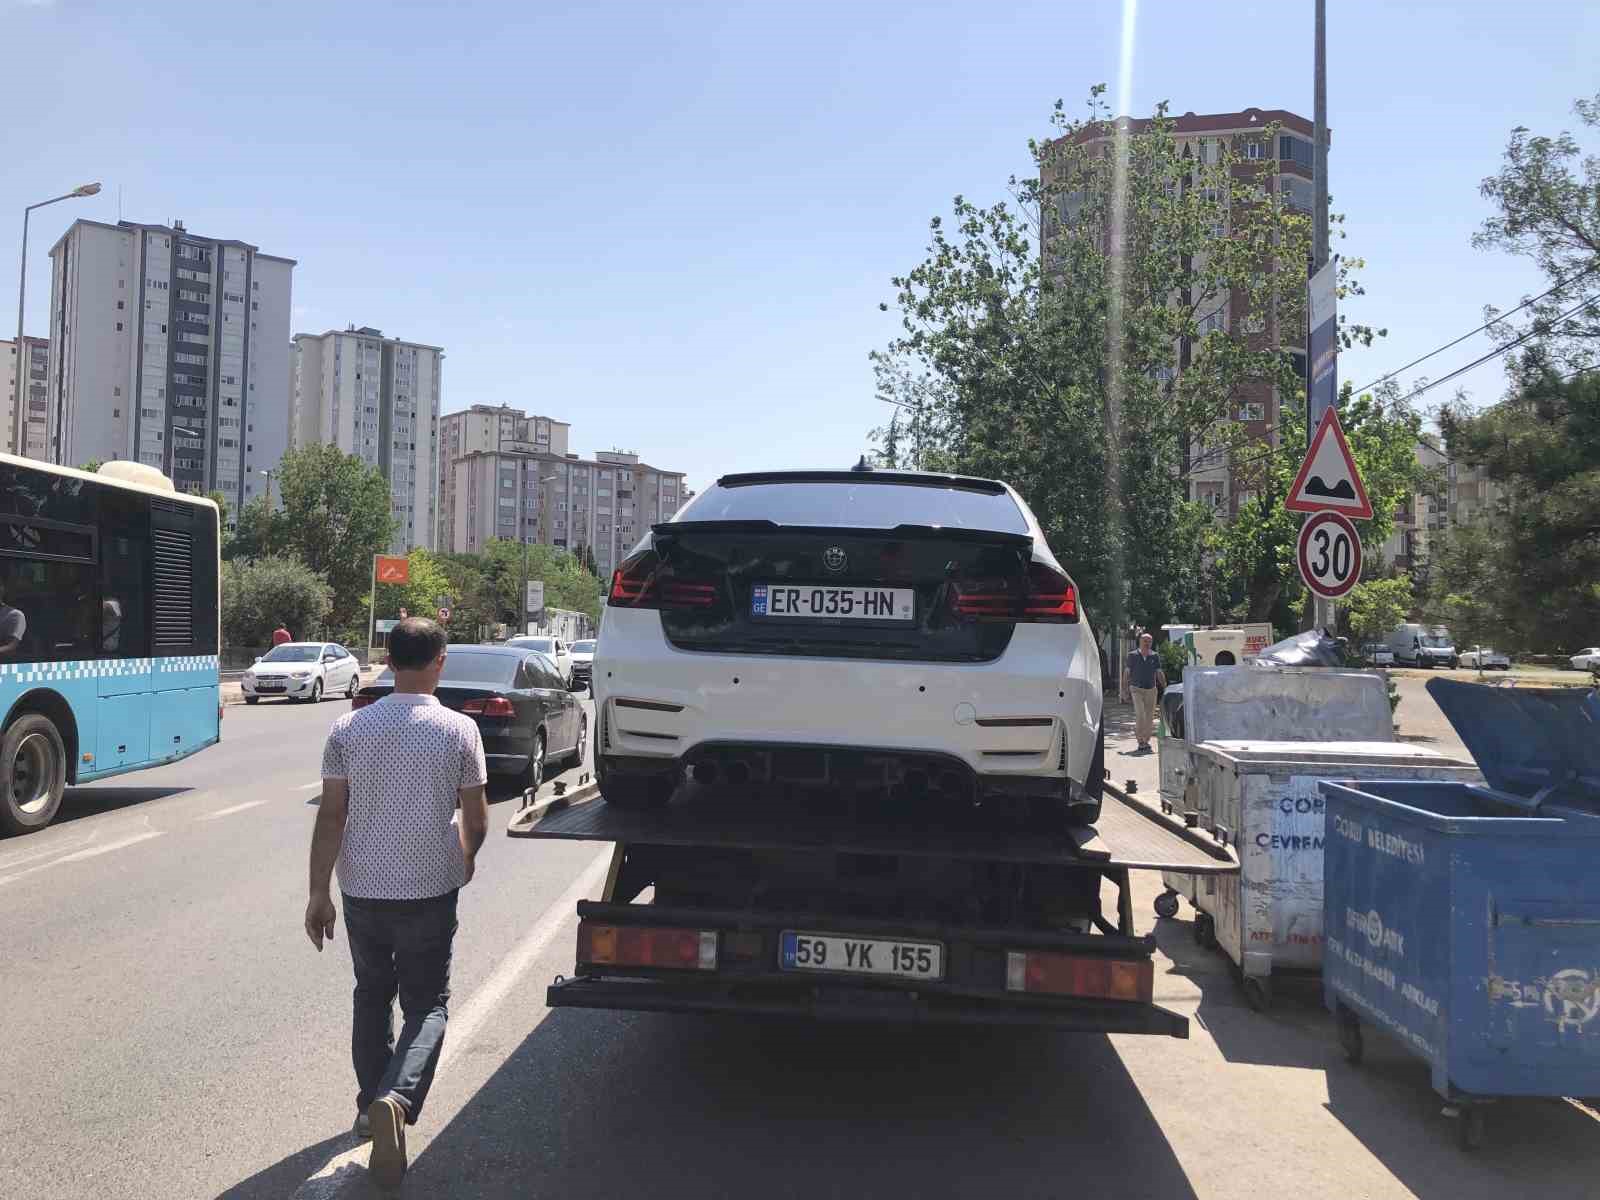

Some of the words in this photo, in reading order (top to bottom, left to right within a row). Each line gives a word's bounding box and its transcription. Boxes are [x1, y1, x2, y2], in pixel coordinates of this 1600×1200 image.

[1312, 529, 1350, 581] 30
[753, 602, 767, 613] GE
[771, 588, 894, 616] ER-035-HN
[797, 939, 827, 965] 59
[844, 942, 873, 969] YK
[891, 944, 932, 973] 155
